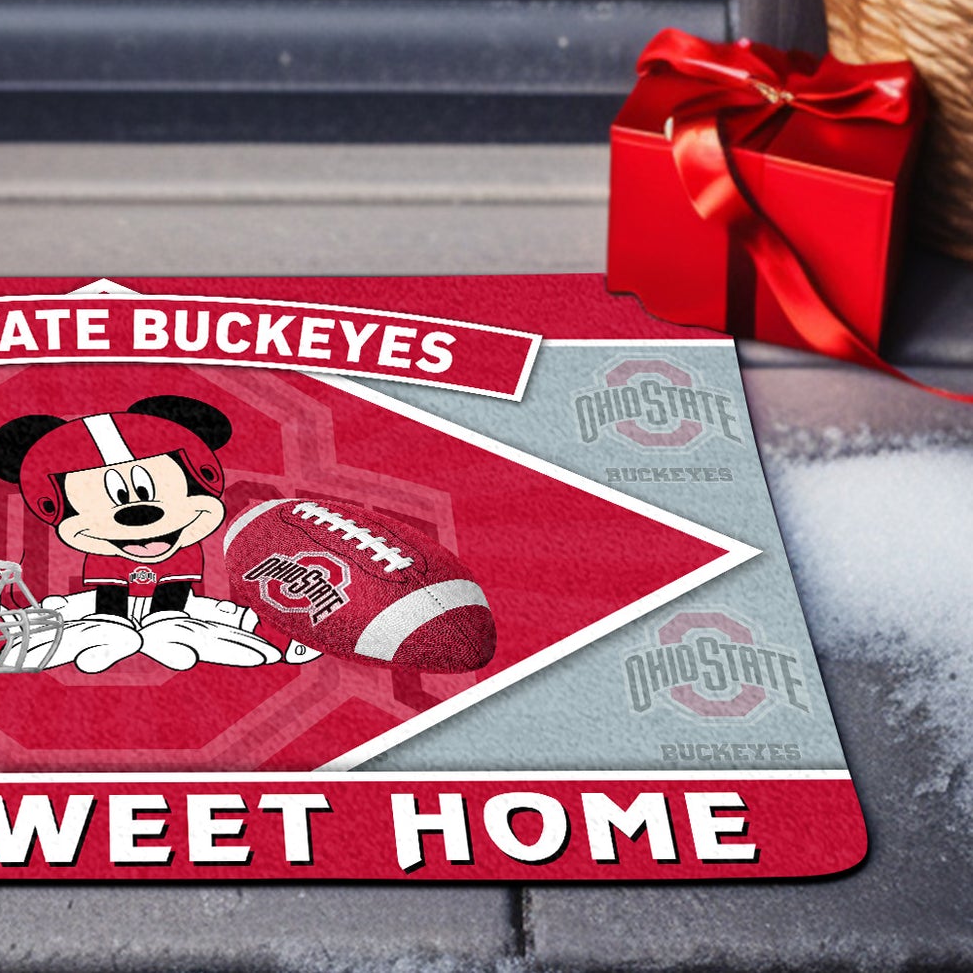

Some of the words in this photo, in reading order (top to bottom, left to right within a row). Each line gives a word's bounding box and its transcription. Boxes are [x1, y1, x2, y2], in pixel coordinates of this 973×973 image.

[133, 308, 457, 374] BUCKEYES
[605, 467, 734, 483] BUCKEYES
[659, 743, 802, 762] BUCKEYES
[390, 791, 759, 873] HOME
